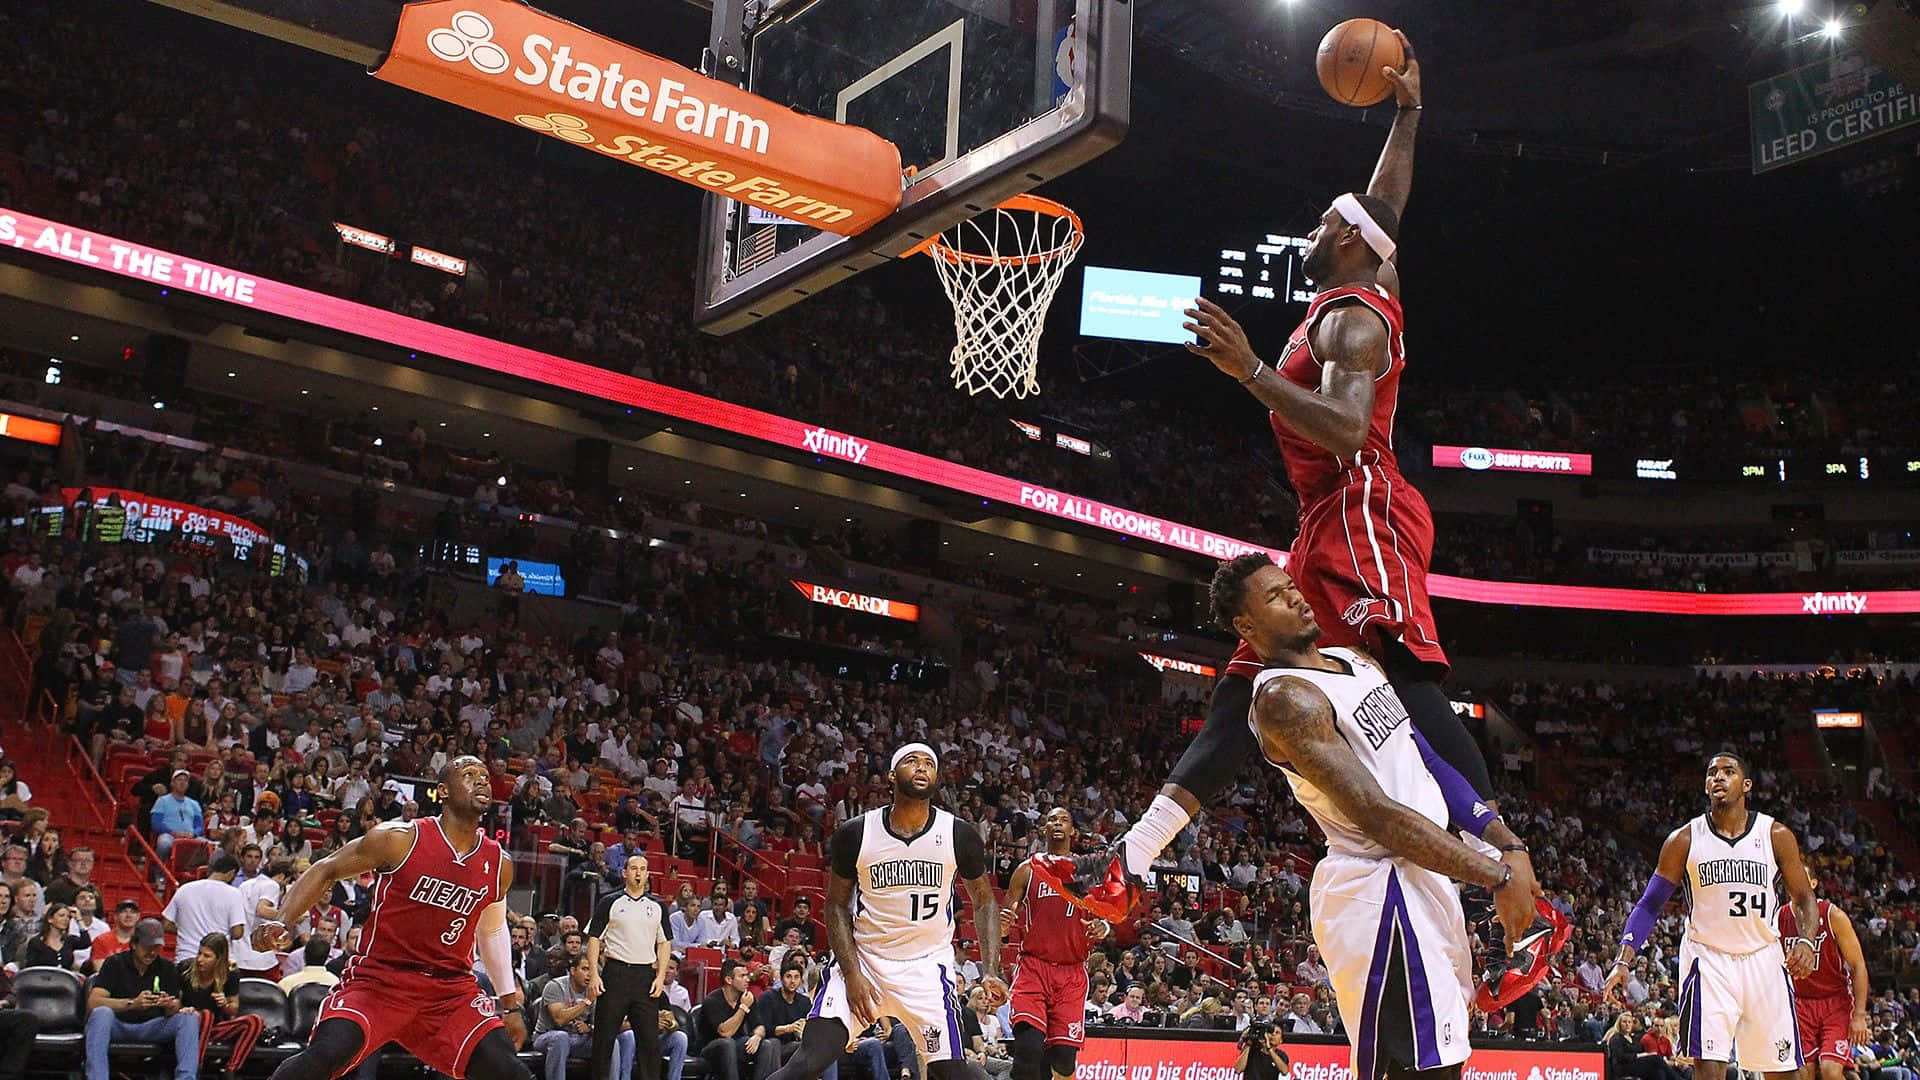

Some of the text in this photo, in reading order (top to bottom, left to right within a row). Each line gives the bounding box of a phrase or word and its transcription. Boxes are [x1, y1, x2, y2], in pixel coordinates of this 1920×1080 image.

[1807, 84, 1904, 125] IS PROUD TO BE
[1761, 93, 1920, 164] LEED CERTIFI
[34, 227, 100, 263] ALL
[110, 244, 174, 282] THE
[182, 262, 256, 303] TIME
[1495, 453, 1521, 468] SUN
[1742, 465, 1765, 477] 3PM
[1825, 463, 1847, 474] 3PA
[1020, 486, 1058, 513] FOR
[1063, 499, 1096, 522] ALL
[1100, 508, 1165, 543] ROOMS,
[1169, 527, 1200, 549] ALL
[812, 585, 891, 616] BACARDI
[870, 859, 944, 889] SACRAMENTO
[1698, 858, 1768, 888] SACRAMENTO
[409, 875, 489, 916] HEAT
[910, 893, 939, 921] 15
[1728, 891, 1767, 918] 34
[440, 917, 467, 945] 3
[1131, 1065, 1153, 1080] up
[1155, 1062, 1183, 1080] big
[1463, 1066, 1518, 1080] discounts
